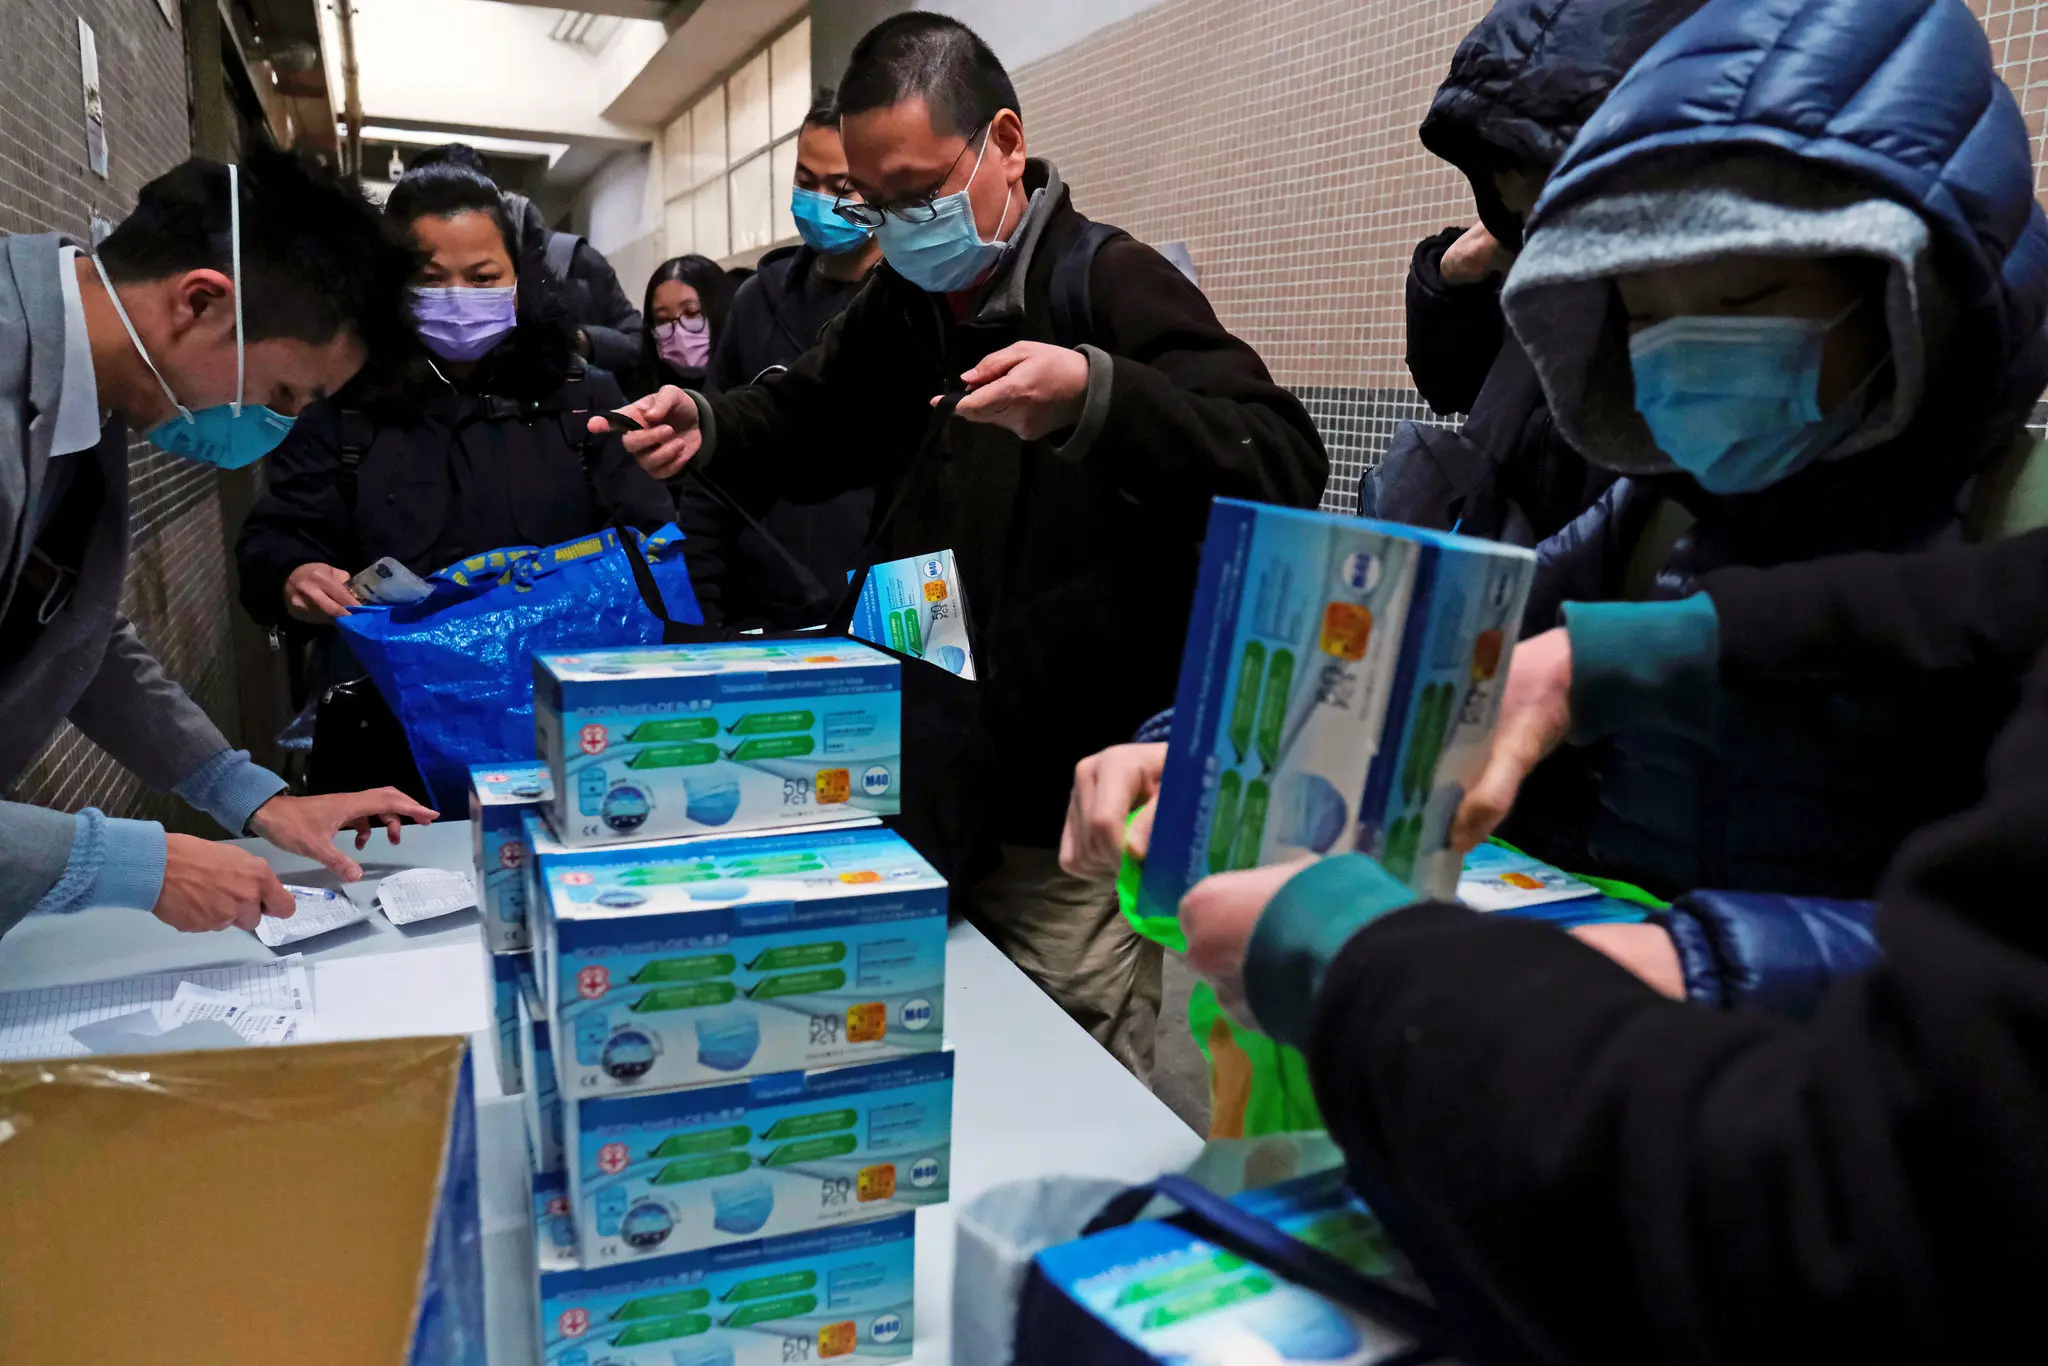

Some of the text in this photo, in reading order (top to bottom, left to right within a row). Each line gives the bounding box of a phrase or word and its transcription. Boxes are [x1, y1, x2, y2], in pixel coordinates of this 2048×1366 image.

[928, 561, 938, 576] M40
[930, 604, 944, 620] 50
[783, 776, 809, 797] 50
[865, 773, 889, 787] M40
[783, 794, 808, 805] PCS
[904, 1006, 930, 1021] M40
[912, 1165, 939, 1179] M40
[873, 1320, 900, 1336] M40
